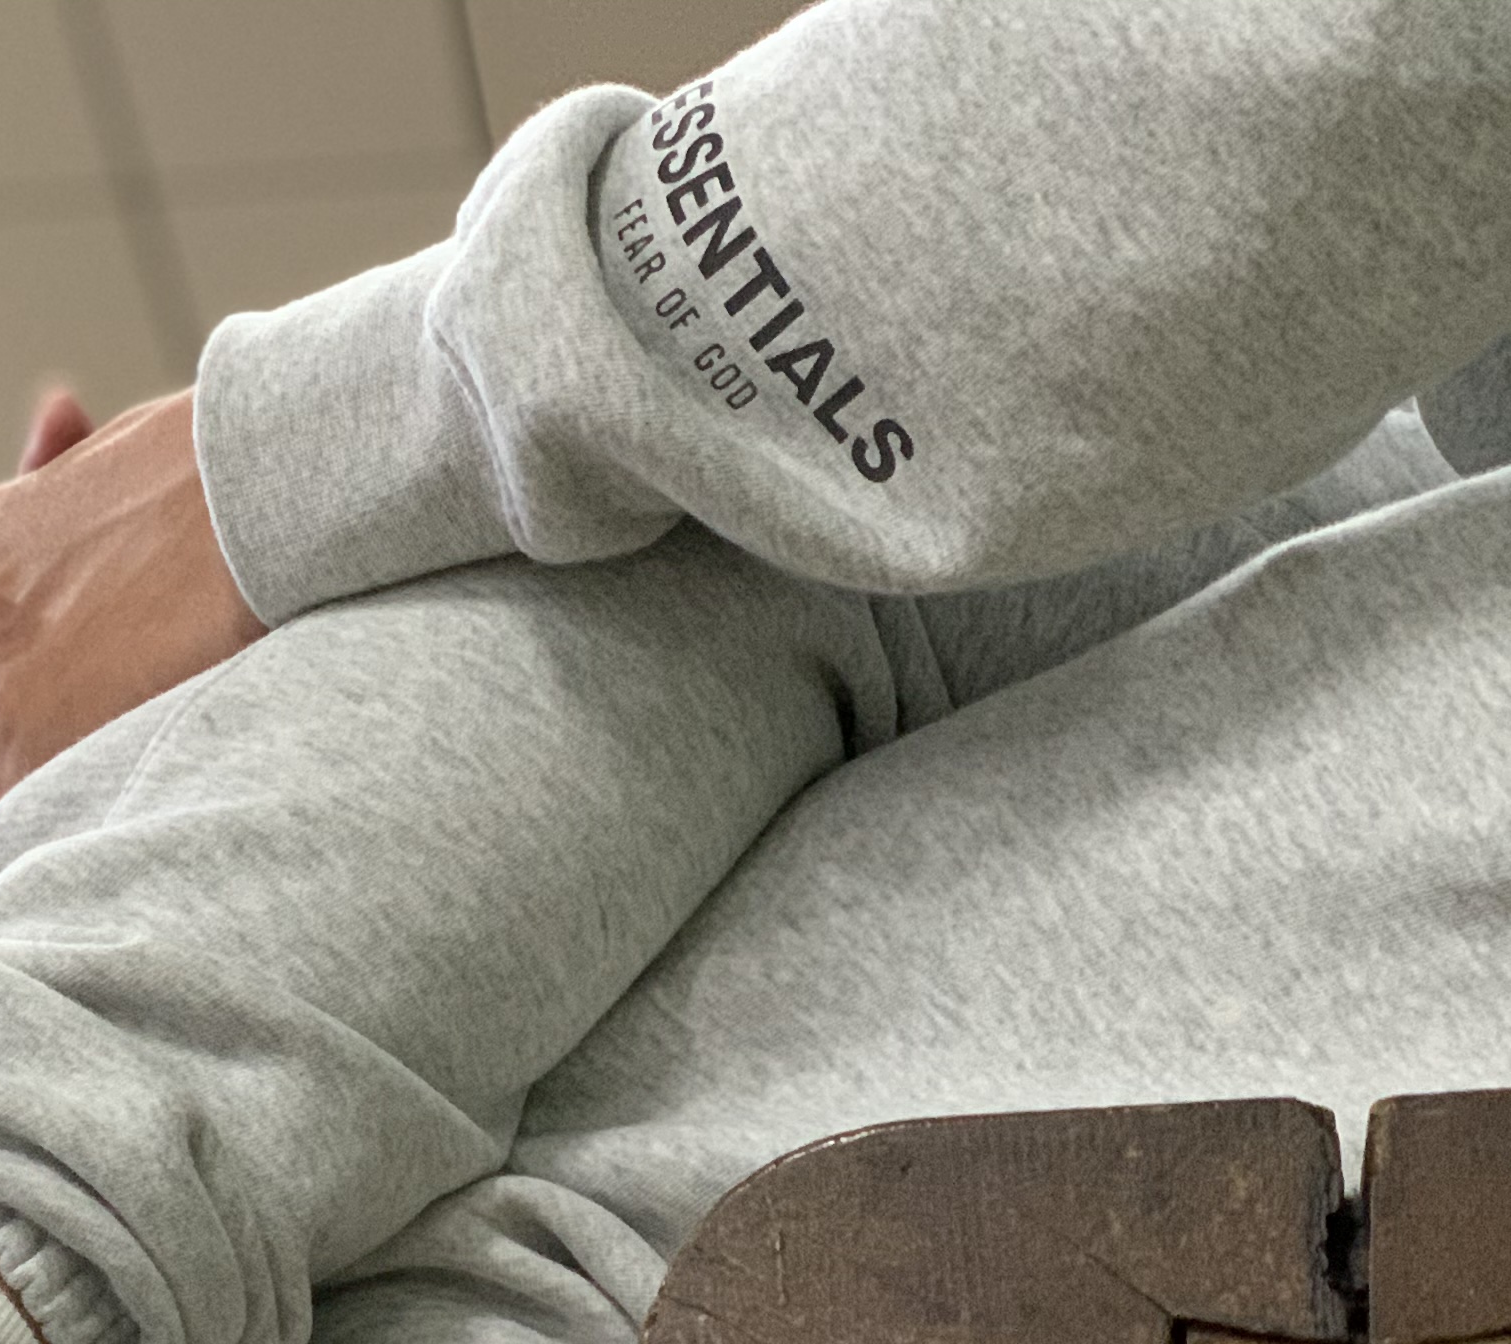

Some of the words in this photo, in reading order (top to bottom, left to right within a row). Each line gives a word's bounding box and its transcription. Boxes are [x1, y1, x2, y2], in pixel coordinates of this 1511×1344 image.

[613, 198, 667, 284] FEAR
[655, 287, 701, 330] OF
[694, 343, 758, 410] GOD
